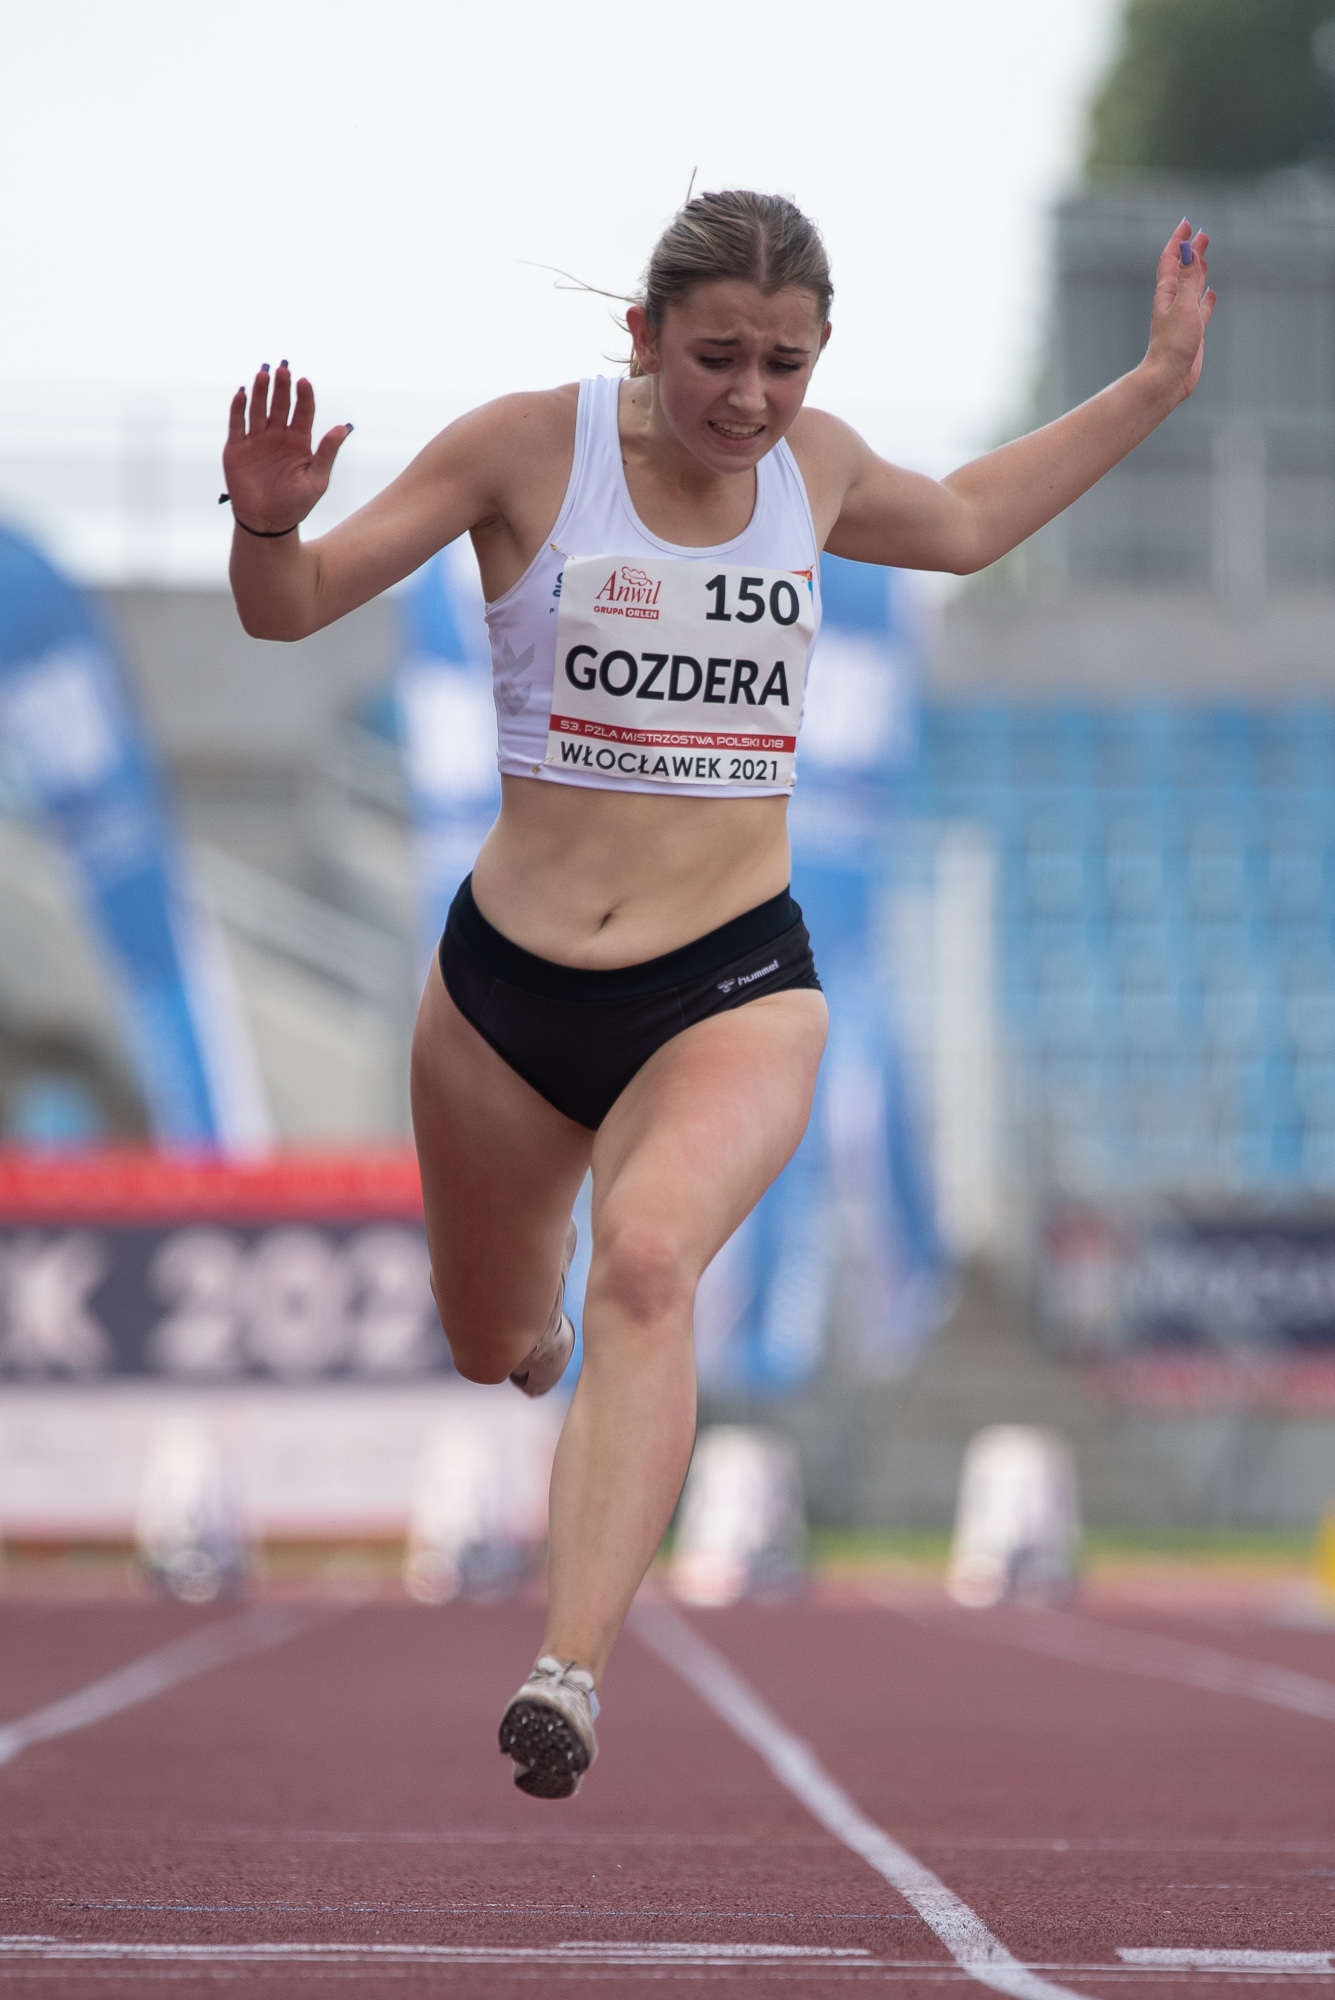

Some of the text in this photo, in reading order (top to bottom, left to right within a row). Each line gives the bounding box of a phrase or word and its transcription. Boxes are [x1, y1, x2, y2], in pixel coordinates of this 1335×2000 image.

[594, 570, 662, 605] Anwil
[704, 574, 800, 626] 150
[593, 605, 658, 619] GRUPA ORLEN
[564, 644, 790, 706] GOZDERA
[560, 720, 785, 749] 53. PZLA MISTRZOSTWA POLSKI U18
[560, 740, 778, 781] WŁOCŁAWEK 2021
[737, 959, 780, 986] hummel
